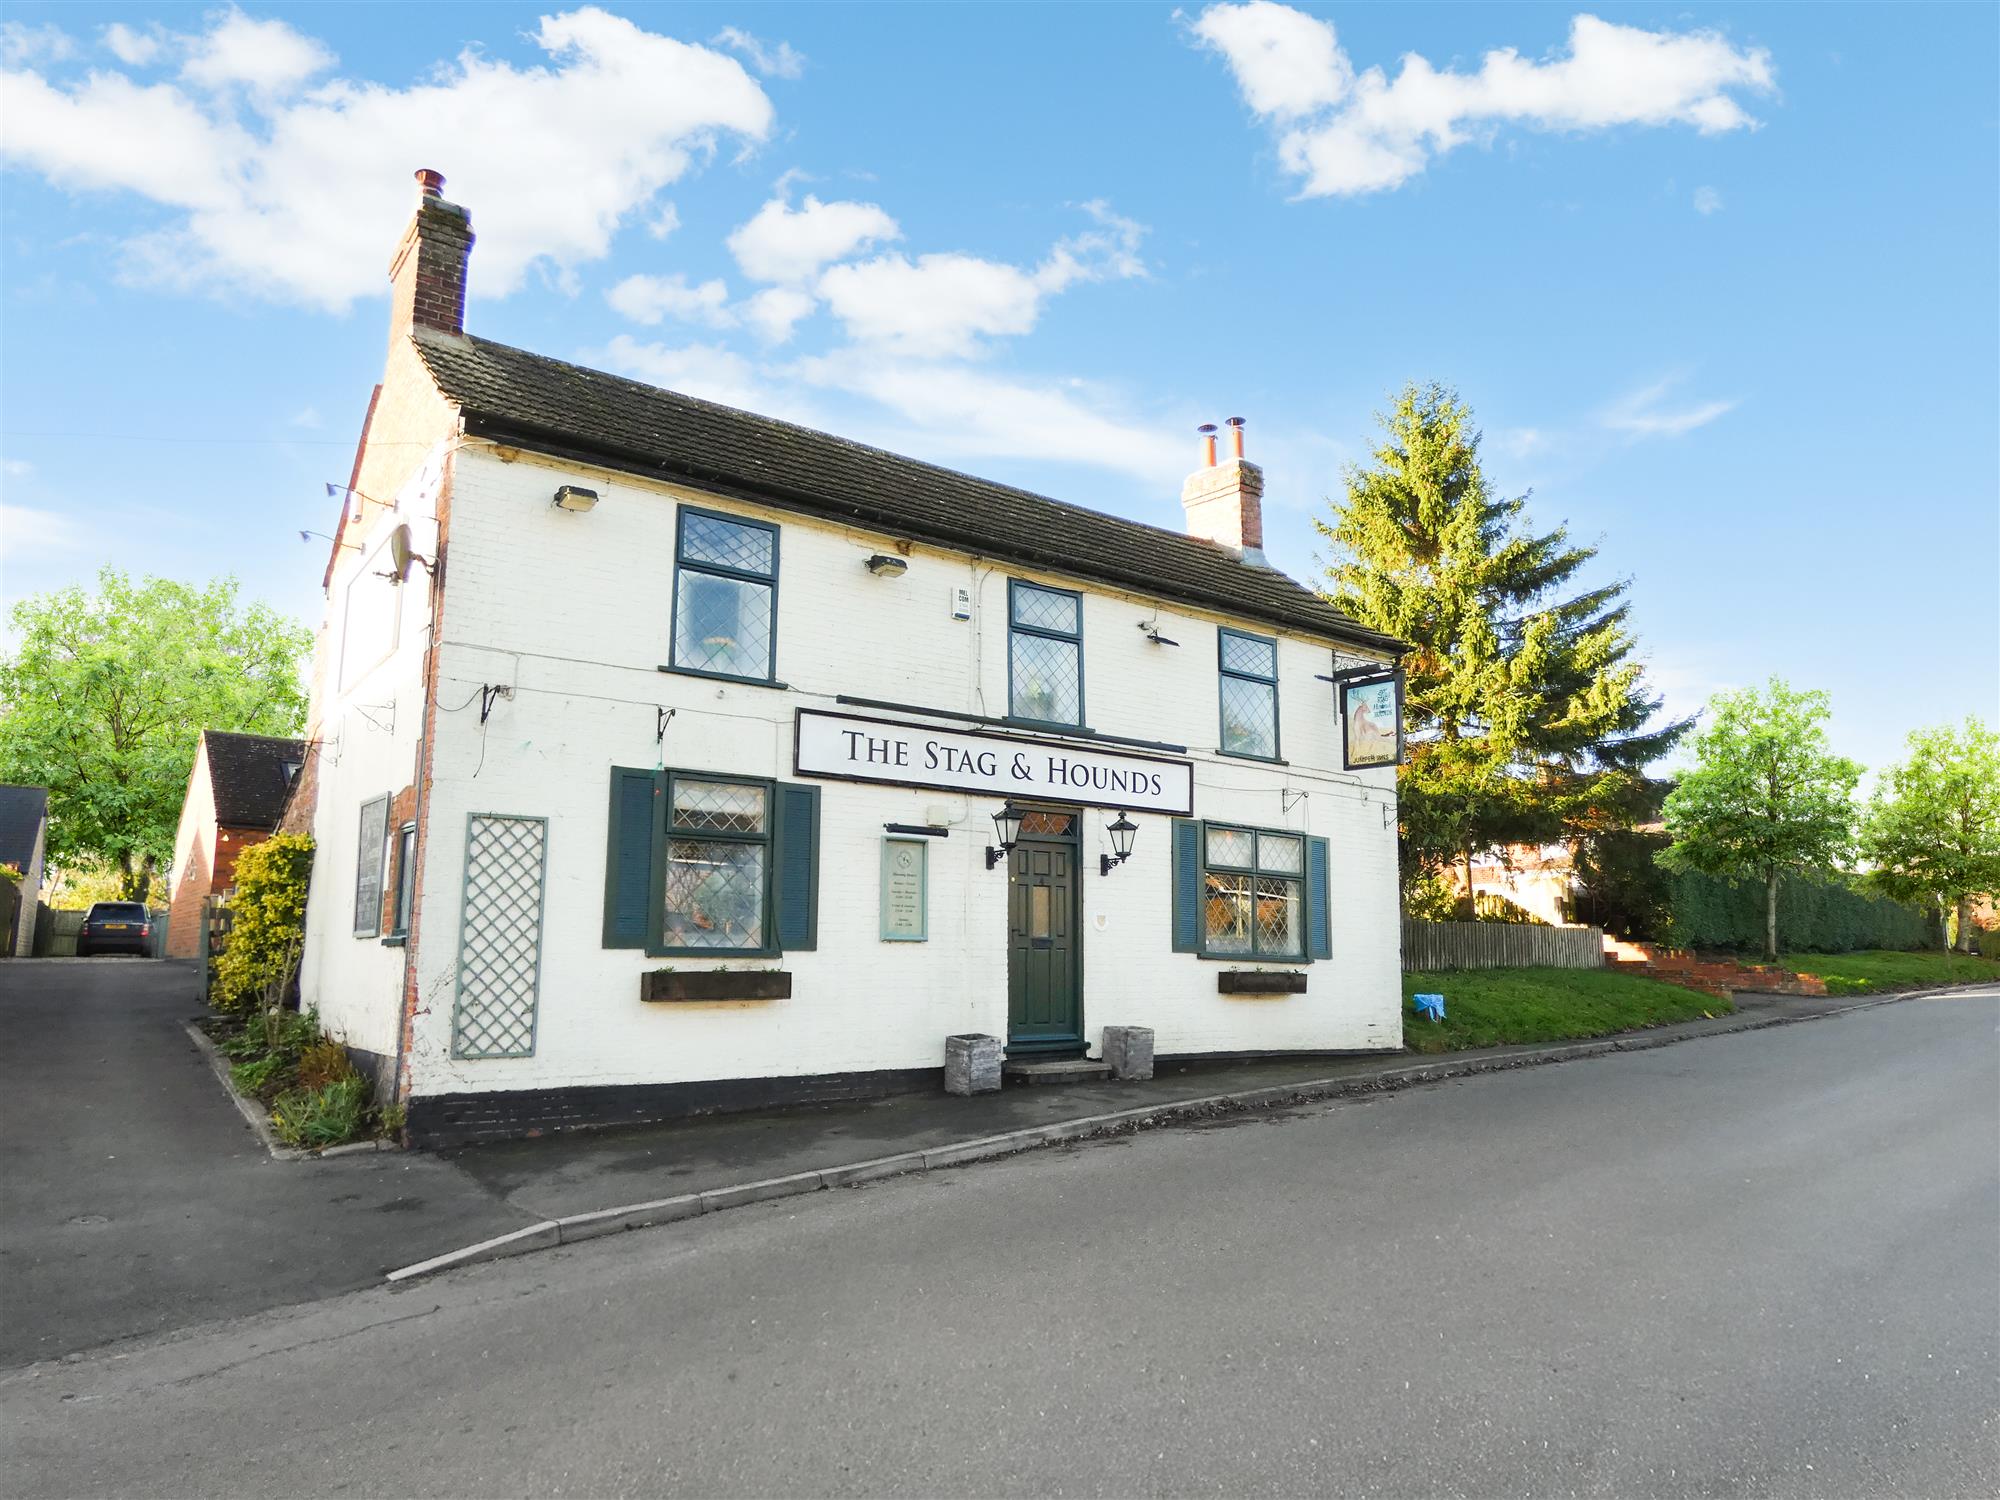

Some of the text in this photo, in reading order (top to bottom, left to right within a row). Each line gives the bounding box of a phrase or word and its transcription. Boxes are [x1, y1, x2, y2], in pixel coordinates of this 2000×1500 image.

[841, 729, 1162, 796] THE STAG & HOUNDS
